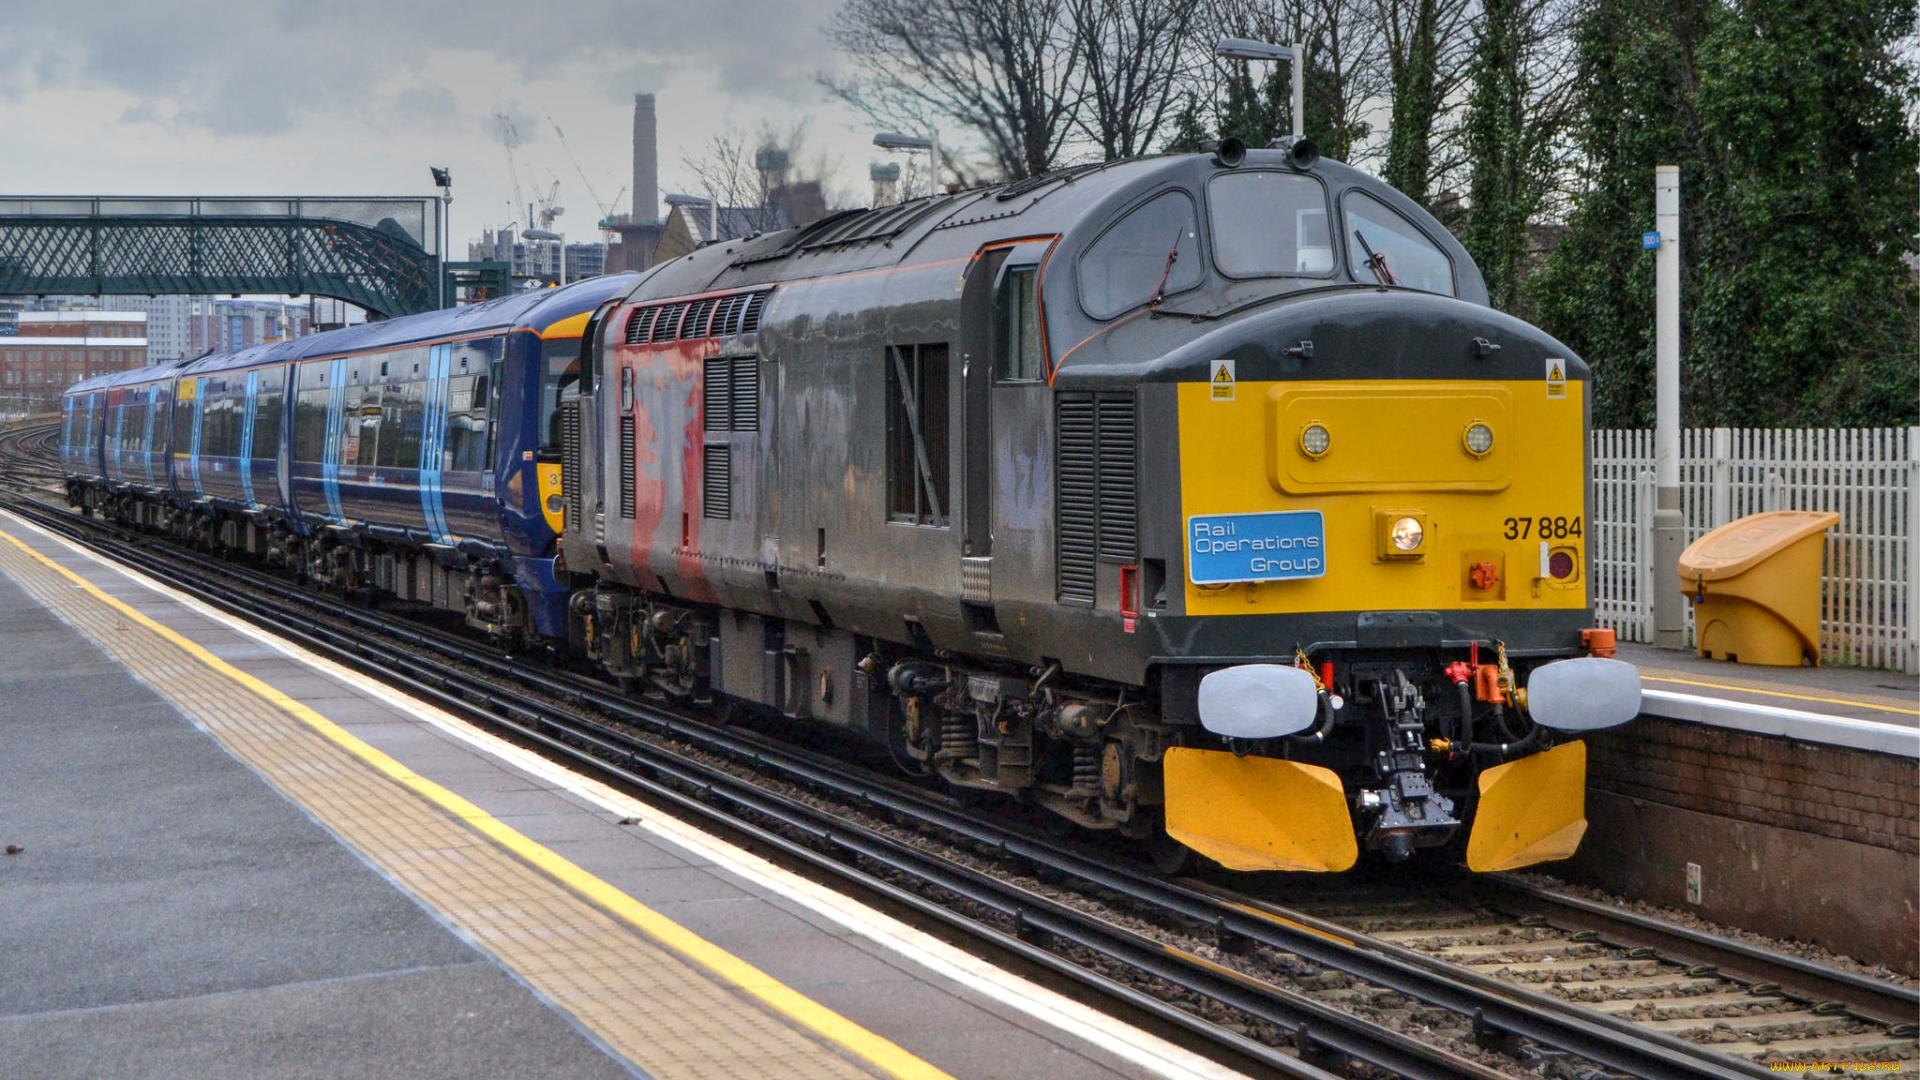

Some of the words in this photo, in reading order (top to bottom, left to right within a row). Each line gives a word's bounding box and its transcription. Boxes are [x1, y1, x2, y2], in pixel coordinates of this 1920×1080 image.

[1194, 522, 1236, 537] Rail
[1503, 517, 1533, 540] 37
[1538, 516, 1582, 539] 884
[1195, 535, 1320, 555] Operations
[1250, 557, 1321, 573] Group
